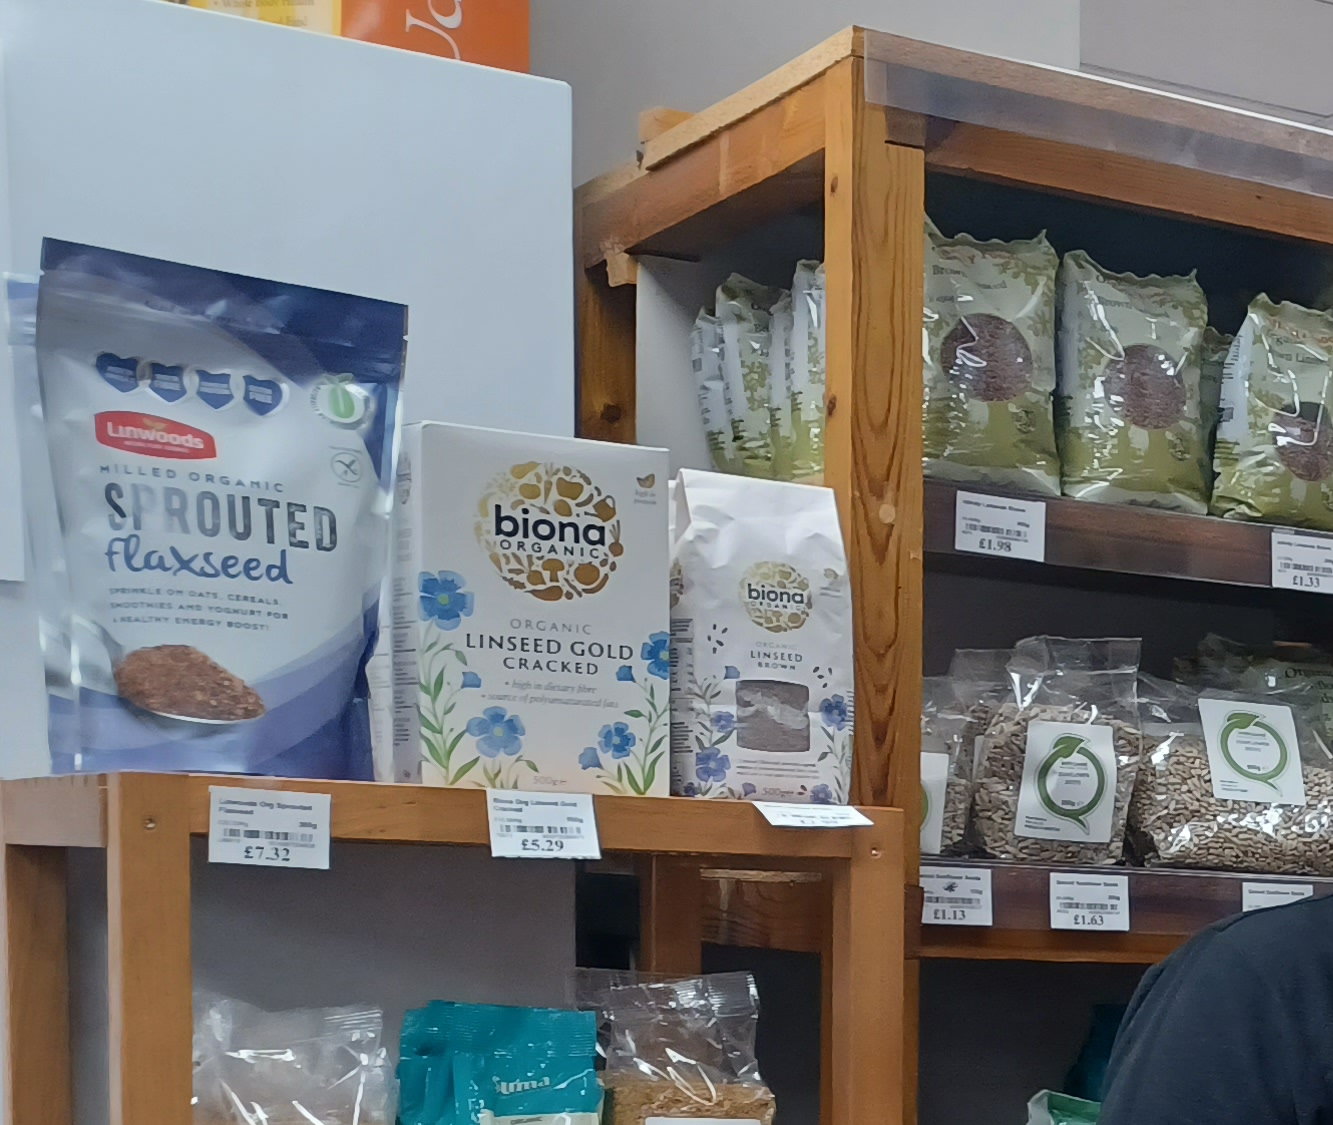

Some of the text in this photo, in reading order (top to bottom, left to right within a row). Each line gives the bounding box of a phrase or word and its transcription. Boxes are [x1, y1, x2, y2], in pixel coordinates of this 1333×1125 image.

[107, 421, 204, 449] Linwoods
[100, 465, 285, 493] MILLED ORGANIC
[104, 482, 338, 552] SPROUTED
[494, 504, 606, 546] biona
[499, 539, 600, 560] ORGANIC
[978, 537, 1013, 553] £1.98
[104, 533, 294, 584] flaxseed
[1292, 575, 1320, 588] £1.33
[748, 583, 804, 605] biona
[177, 603, 203, 612] AND
[207, 605, 262, 617] YOGHURT
[266, 611, 289, 620] FOR
[174, 617, 222, 628] ENERGY
[510, 618, 592, 636] ORGANIC
[466, 633, 634, 661] LINSEED GOLD
[750, 650, 803, 663] LINSEED
[503, 657, 599, 675] CRACKED
[244, 845, 291, 862] £7.32
[521, 838, 564, 852] £5.29
[933, 908, 966, 921] £1.13
[1073, 913, 1104, 926] £1.63
